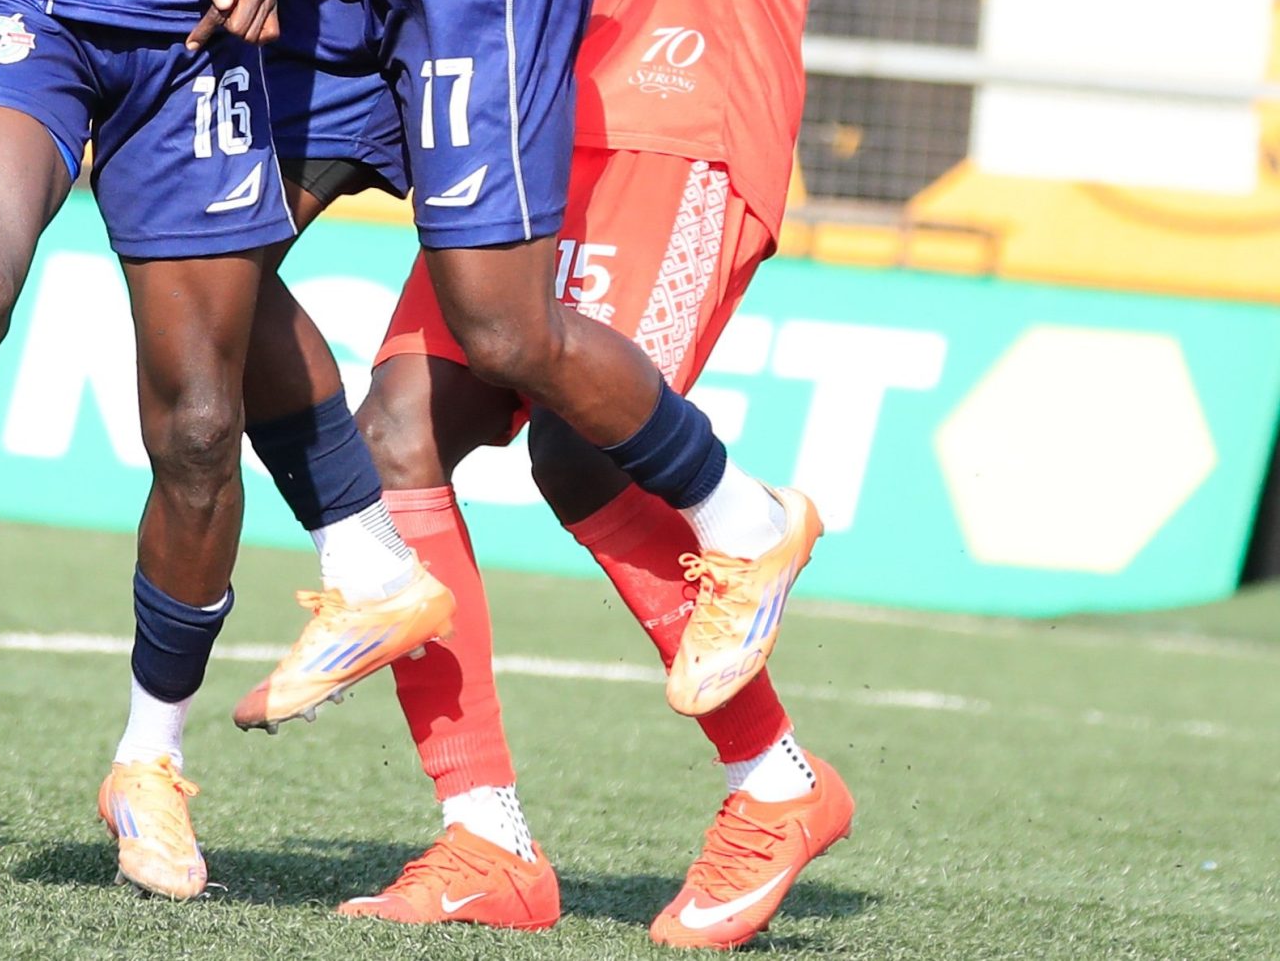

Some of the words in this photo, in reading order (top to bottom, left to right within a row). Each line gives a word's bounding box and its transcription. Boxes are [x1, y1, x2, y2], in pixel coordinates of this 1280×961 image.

[640, 26, 705, 68] 70
[192, 66, 252, 158] 16
[420, 57, 475, 149] 17
[555, 239, 617, 302] 15
